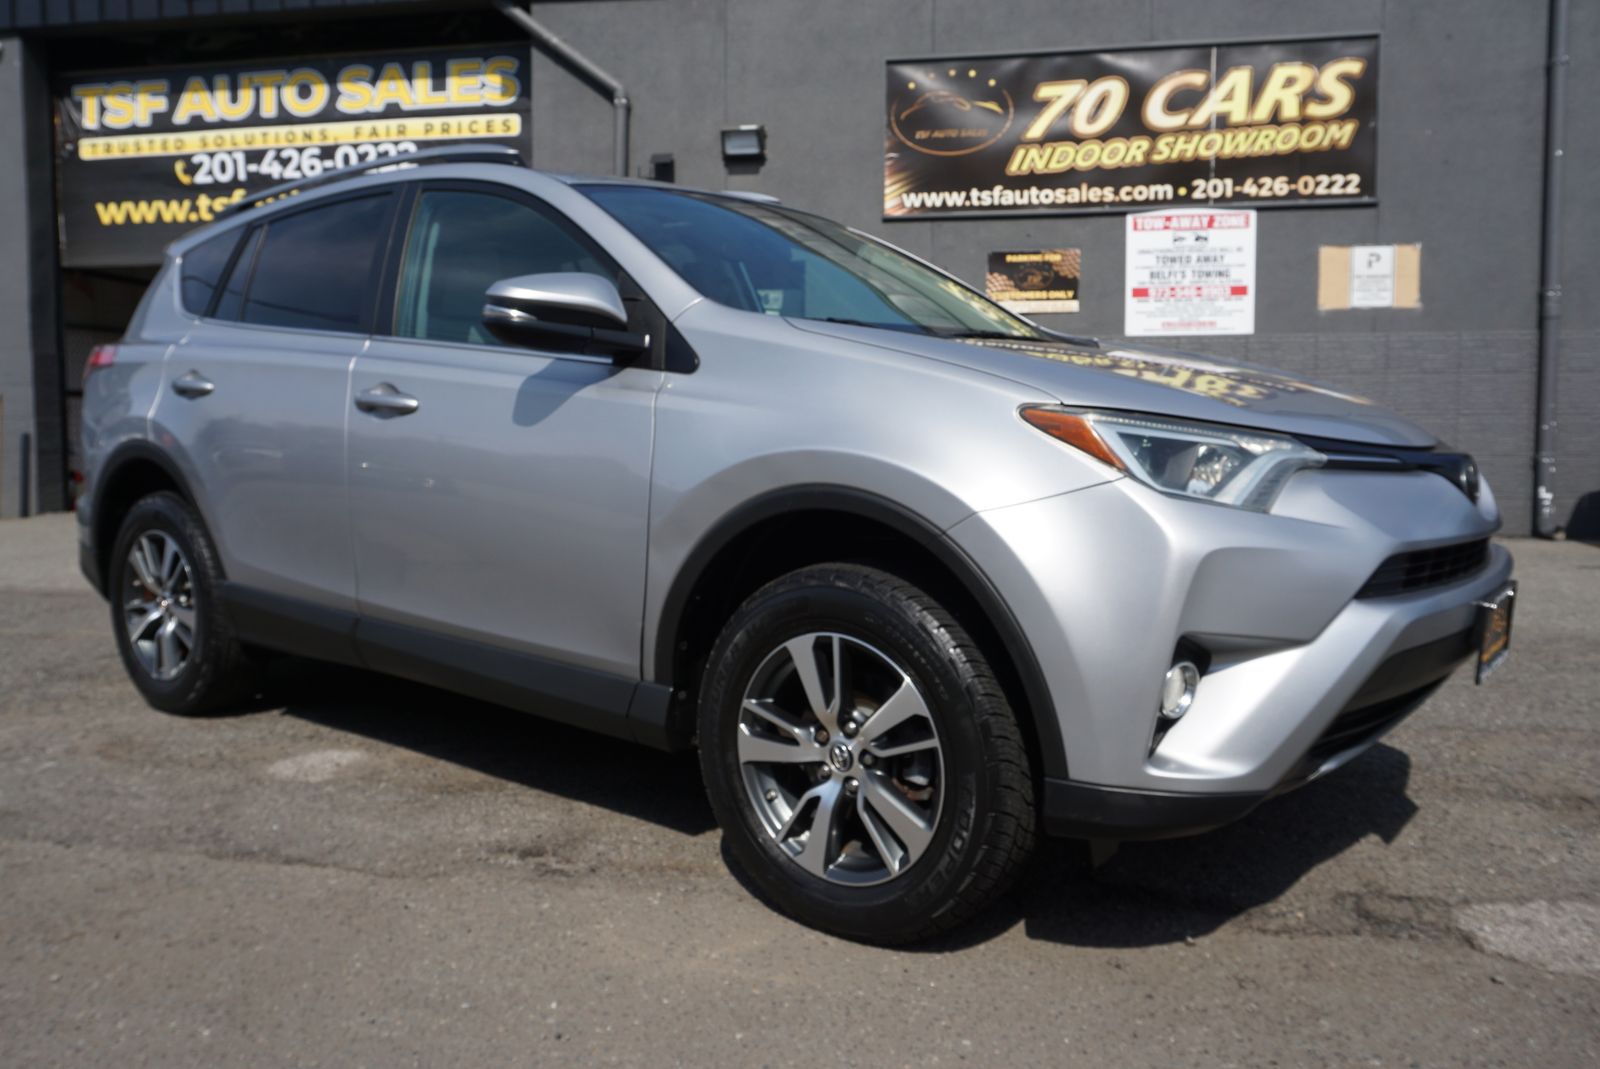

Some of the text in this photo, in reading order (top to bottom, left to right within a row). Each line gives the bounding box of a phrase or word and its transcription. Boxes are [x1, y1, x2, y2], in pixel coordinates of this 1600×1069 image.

[72, 56, 521, 130] TSF AUTO SALES
[1021, 57, 1367, 141] 70 CARS
[88, 119, 512, 153] TRUSTED SOLUTIONS, FAIR PRICES
[1005, 118, 1359, 176] INDOOR SHOWROOM
[902, 173, 1361, 208] www.tsfautosales.com 201-426-0222
[1136, 216, 1209, 230] TOW-AWAY
[1156, 254, 1225, 265] TOWED AWAY
[1191, 269, 1230, 279] TOWING
